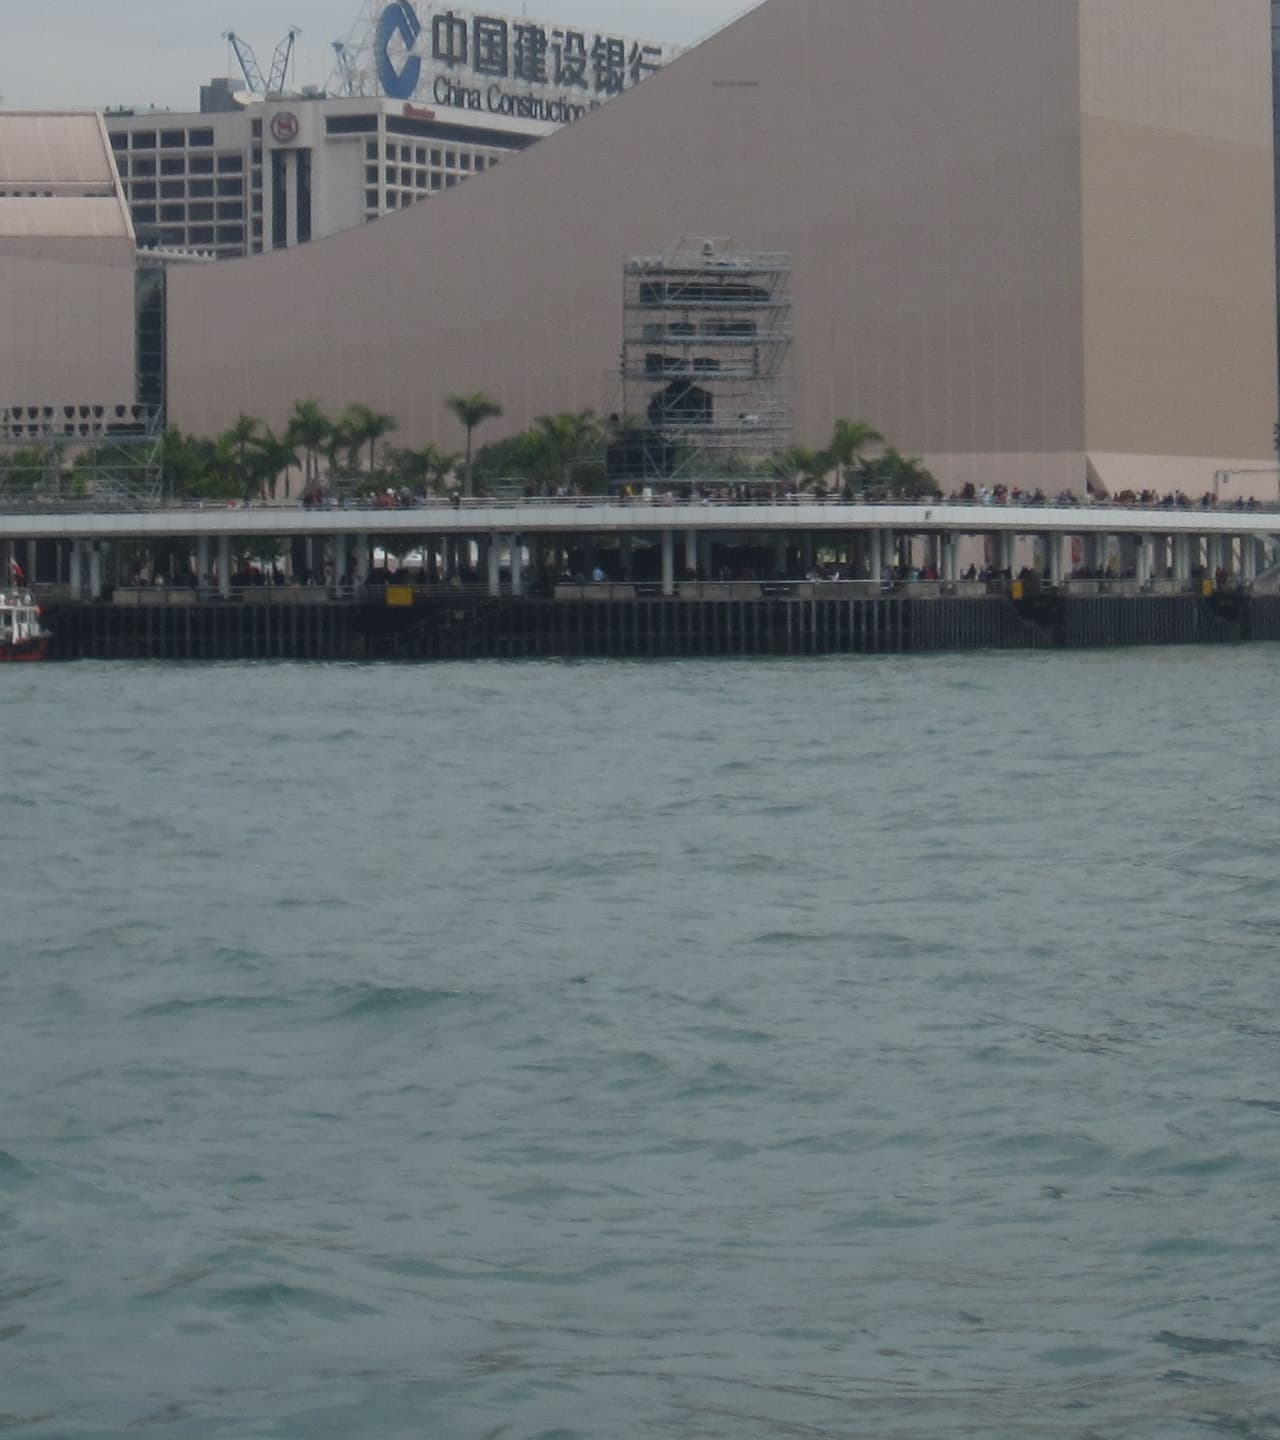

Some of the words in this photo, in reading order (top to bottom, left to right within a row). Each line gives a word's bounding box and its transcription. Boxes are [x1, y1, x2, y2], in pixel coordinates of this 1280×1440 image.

[432, 11, 662, 94] 中国建设银行
[433, 75, 482, 111] China
[487, 84, 586, 124] Construction
